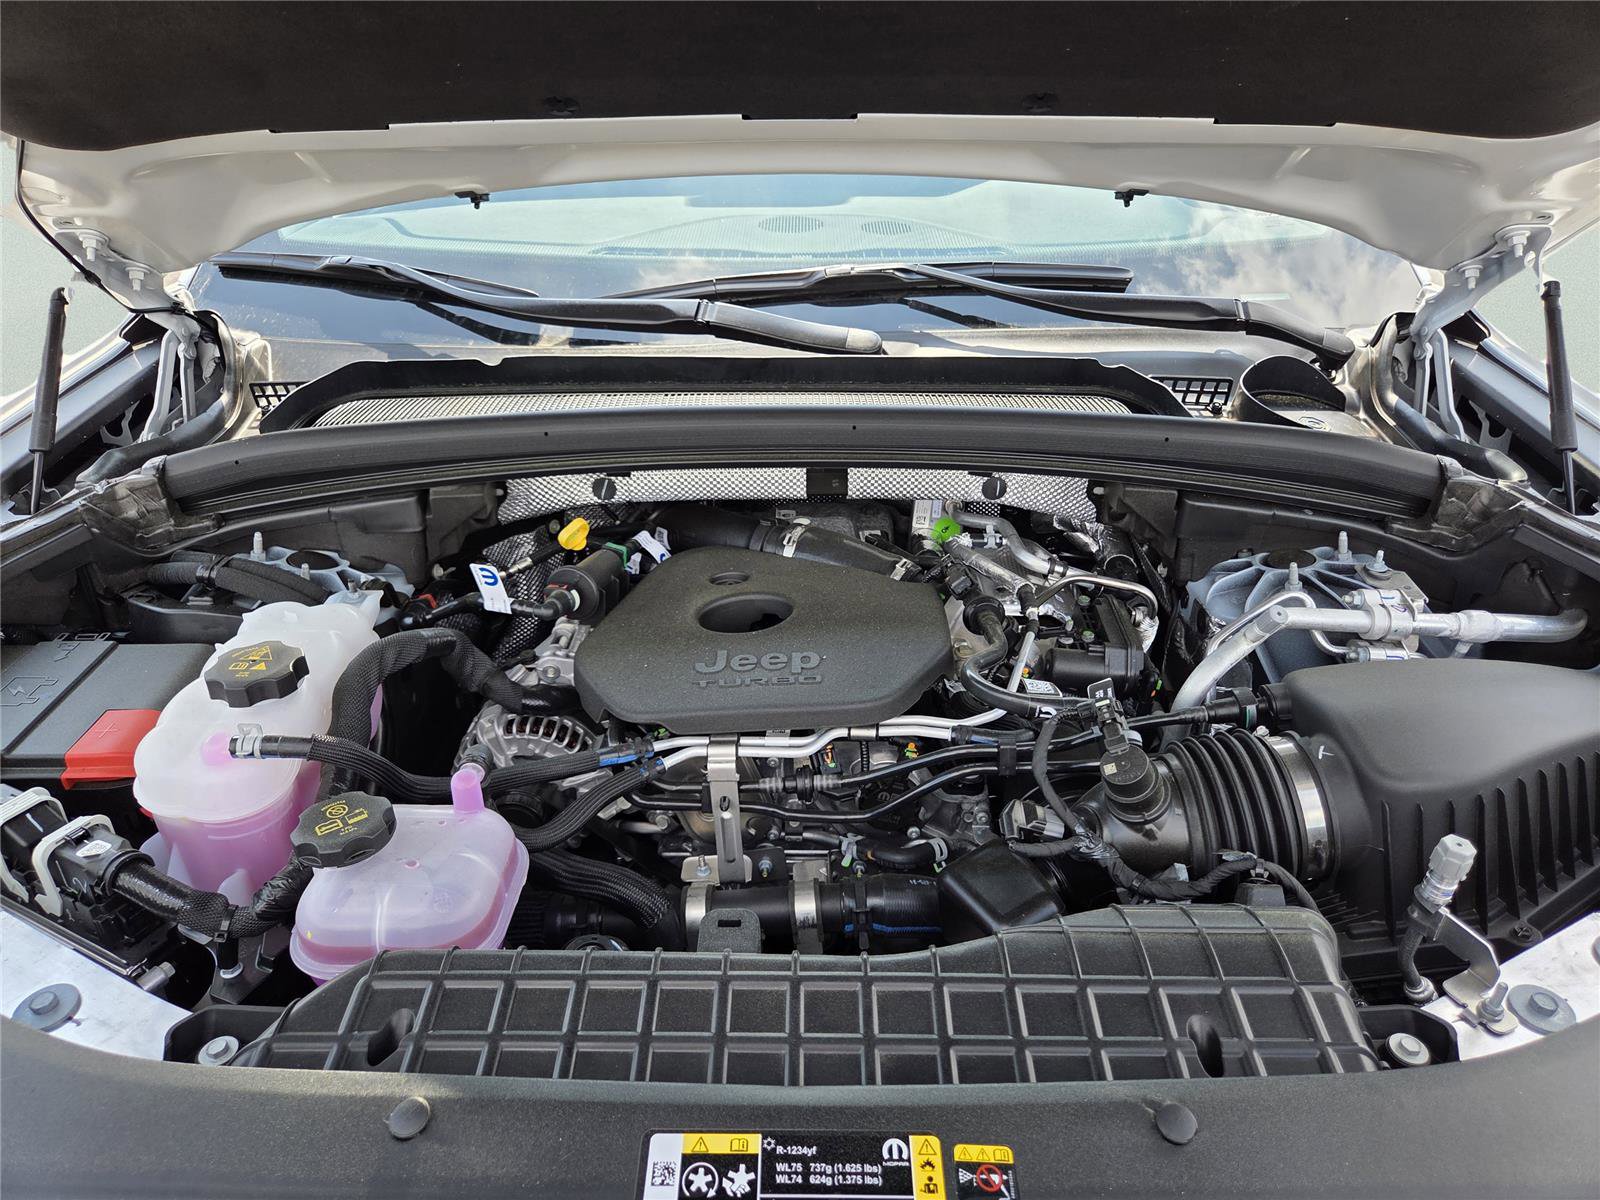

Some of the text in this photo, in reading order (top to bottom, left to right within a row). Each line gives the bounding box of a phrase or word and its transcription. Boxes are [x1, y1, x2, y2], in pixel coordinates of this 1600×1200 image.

[694, 649, 821, 675] Jeep
[692, 675, 822, 688] TURBO
[776, 1145, 817, 1156] R-1234yf
[775, 1162, 882, 1175] WL75 737g (1.625 lbs)
[775, 1174, 883, 1186] WL74 624g (1.375 lbs)
